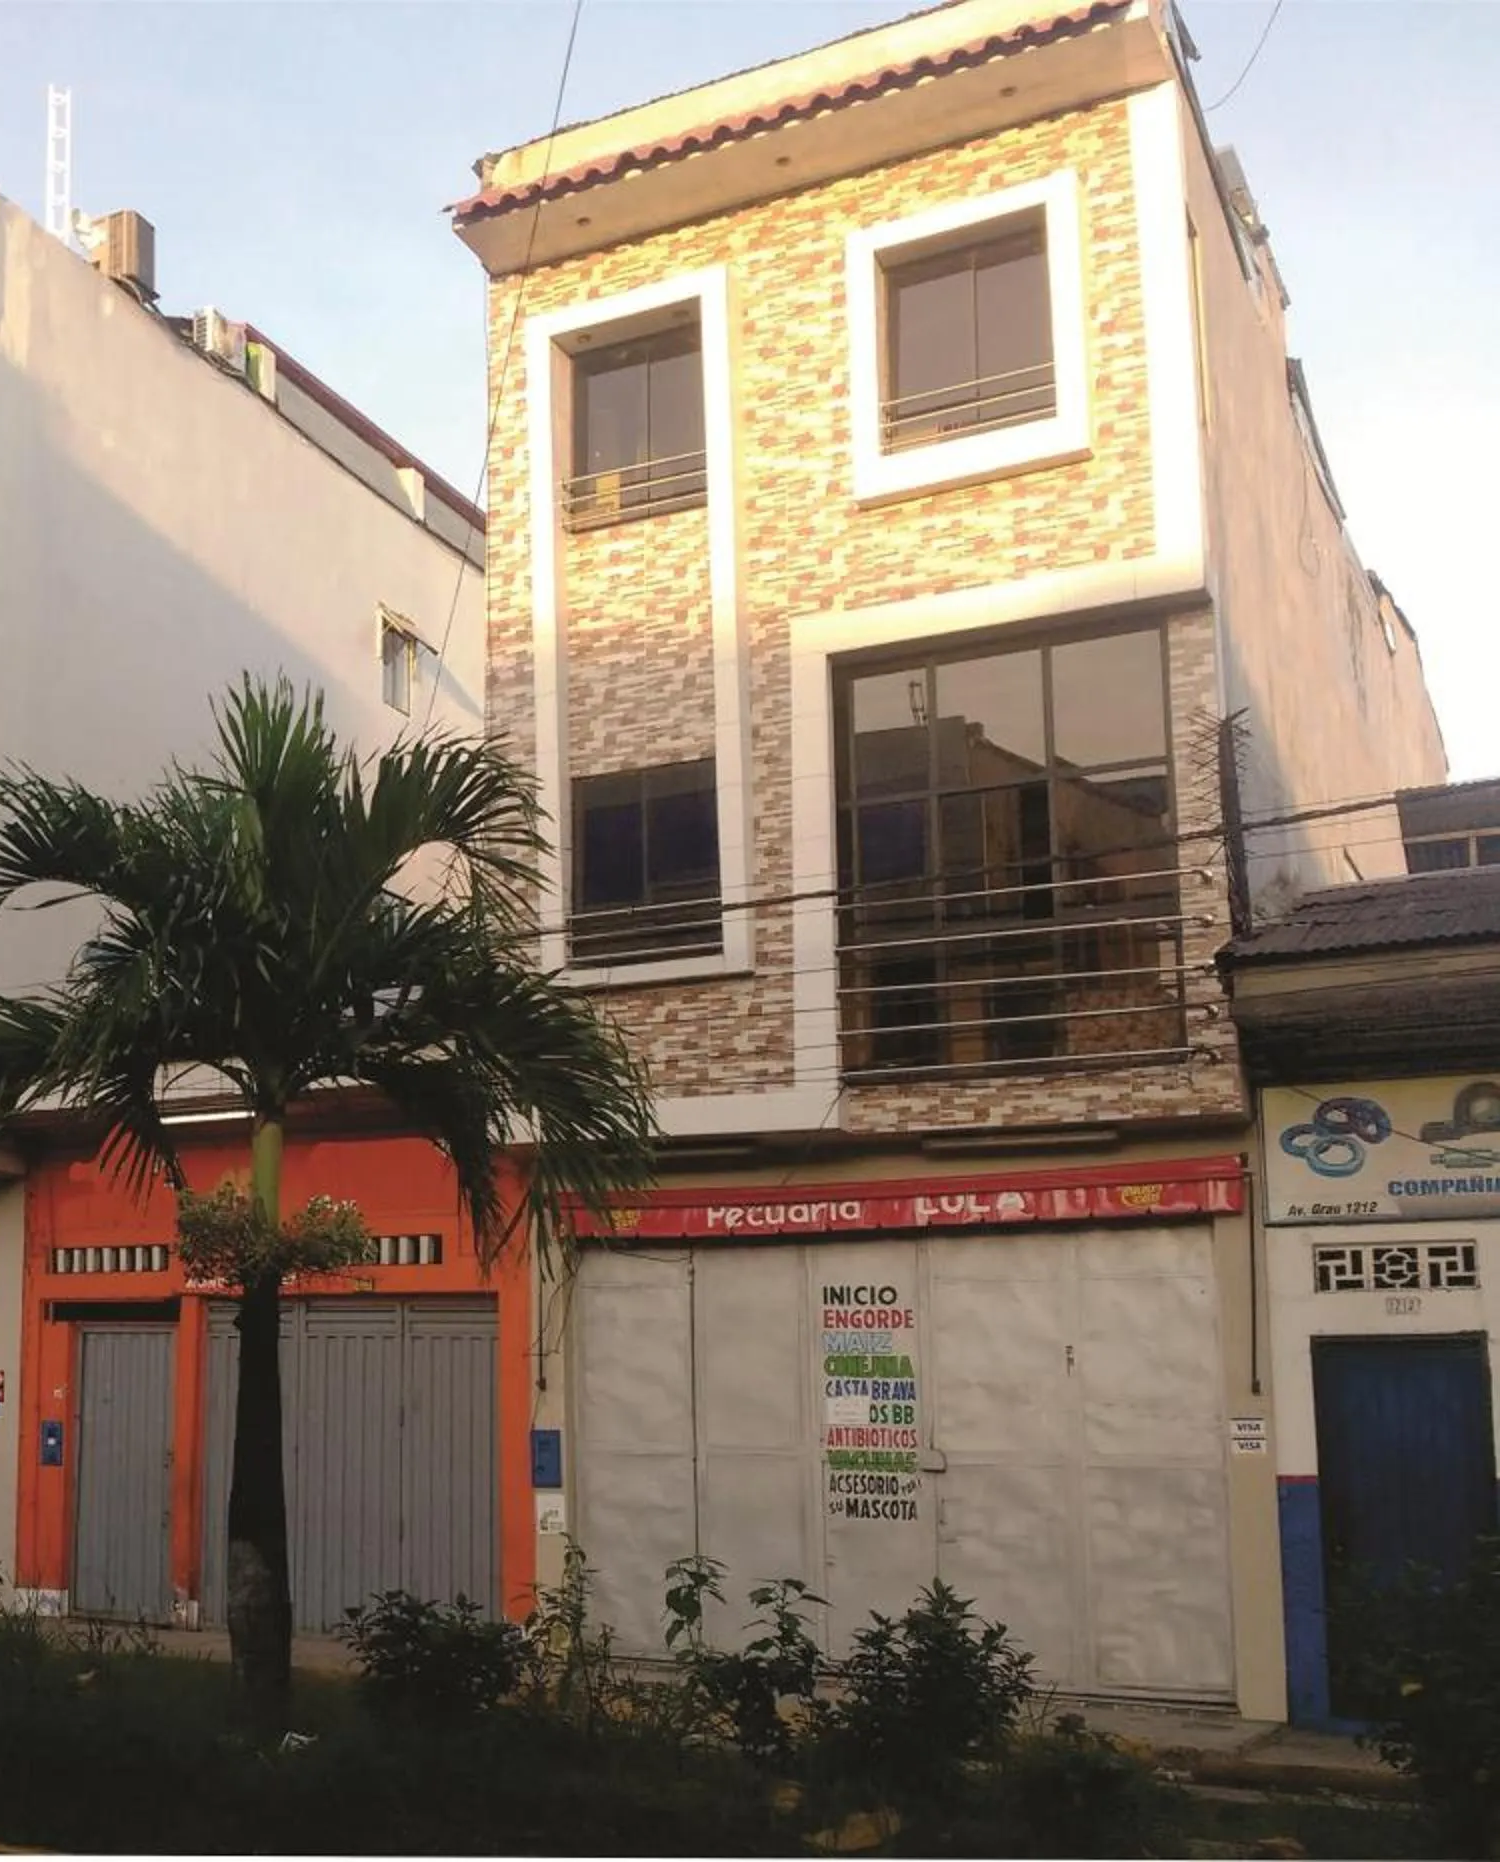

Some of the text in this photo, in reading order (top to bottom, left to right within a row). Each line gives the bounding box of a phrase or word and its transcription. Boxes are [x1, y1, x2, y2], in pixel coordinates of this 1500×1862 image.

[707, 1200, 861, 1228] Pecuaria
[823, 1286, 897, 1305] INICIO
[823, 1309, 914, 1328] ENGORDE
[893, 1404, 914, 1424] BB
[828, 1428, 917, 1448] ANTIBIOTICOS
[830, 1474, 899, 1496] ACSESORIO
[846, 1498, 918, 1520] MASCOTA
